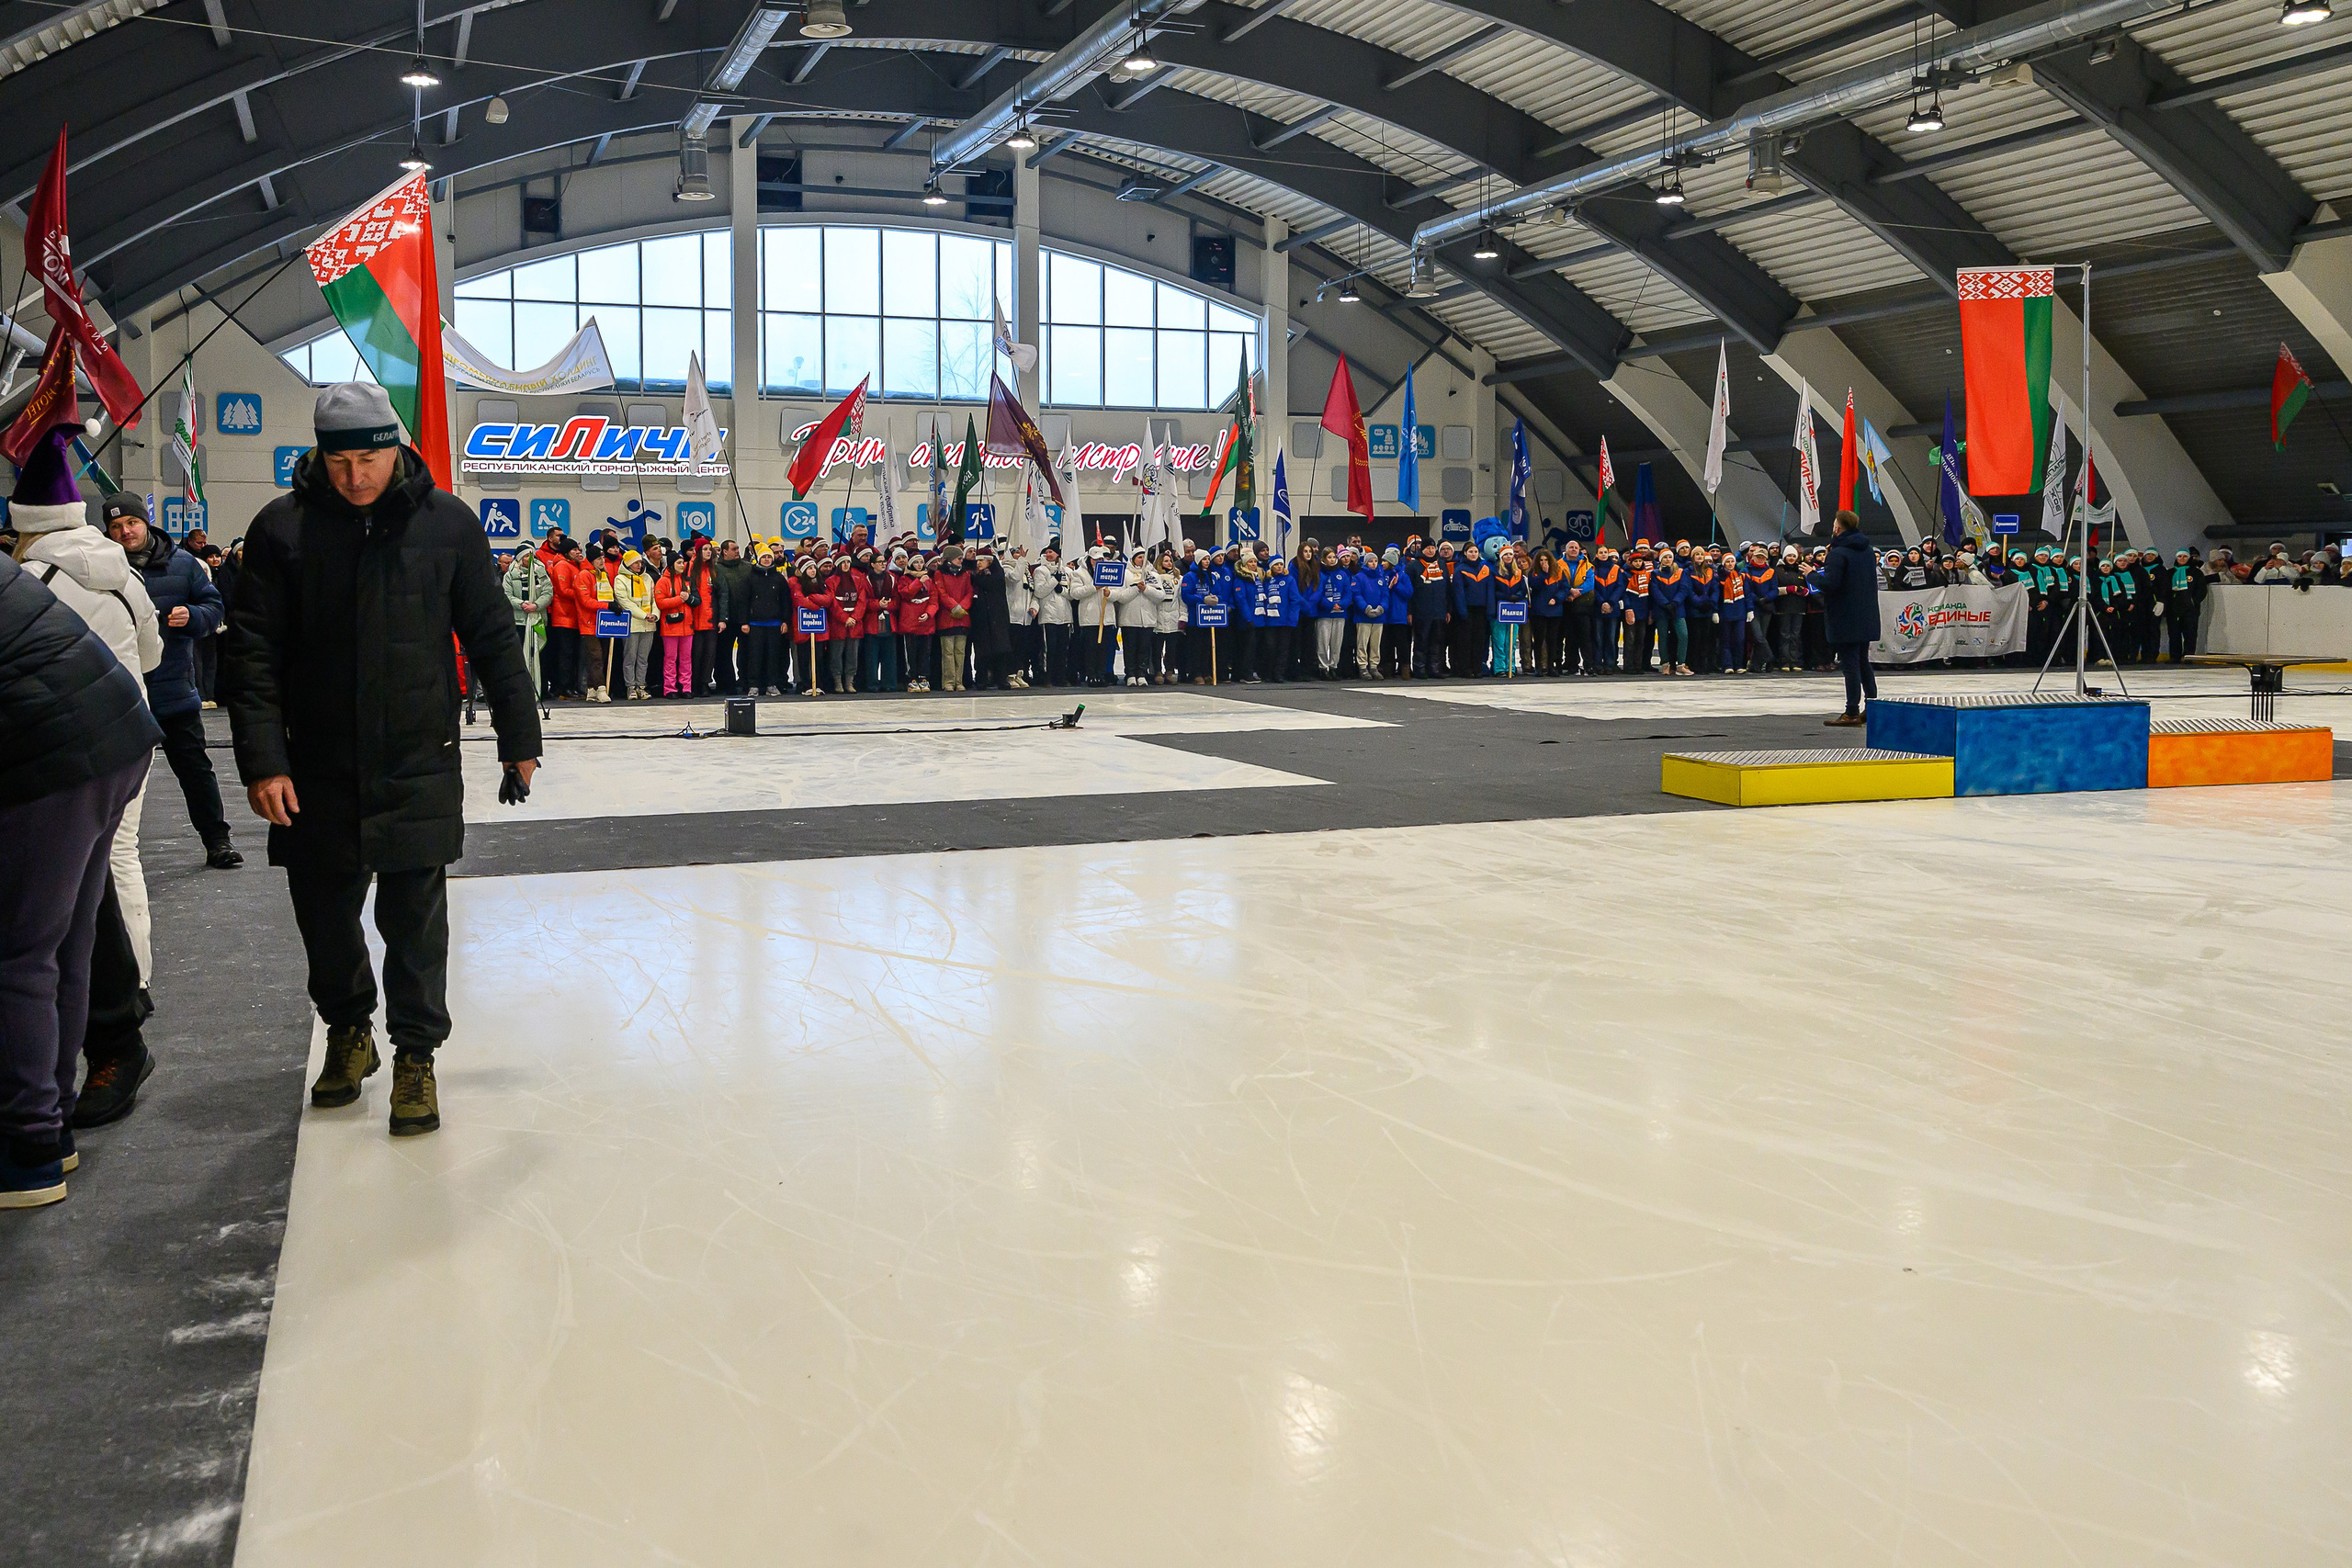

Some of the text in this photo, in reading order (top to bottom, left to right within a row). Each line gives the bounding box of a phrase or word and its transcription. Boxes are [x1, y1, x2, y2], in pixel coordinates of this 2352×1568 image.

[550, 355, 597, 383] ХОЛДИНГ
[571, 367, 601, 383] БЕЛАРУСЬ
[463, 461, 591, 472] РЕСПУБЛИКАНСКИЙ
[593, 462, 689, 474] ГОРНОЛЫЖНЫЙ
[885, 495, 895, 528] фабрика
[801, 515, 817, 525] 24
[1102, 566, 1119, 574] Белые
[1100, 574, 1118, 582] тигры
[1501, 608, 1523, 616] Молния
[1928, 602, 1967, 613] КОМАНДА
[1928, 611, 1992, 626] ЕДИНЫЕ
